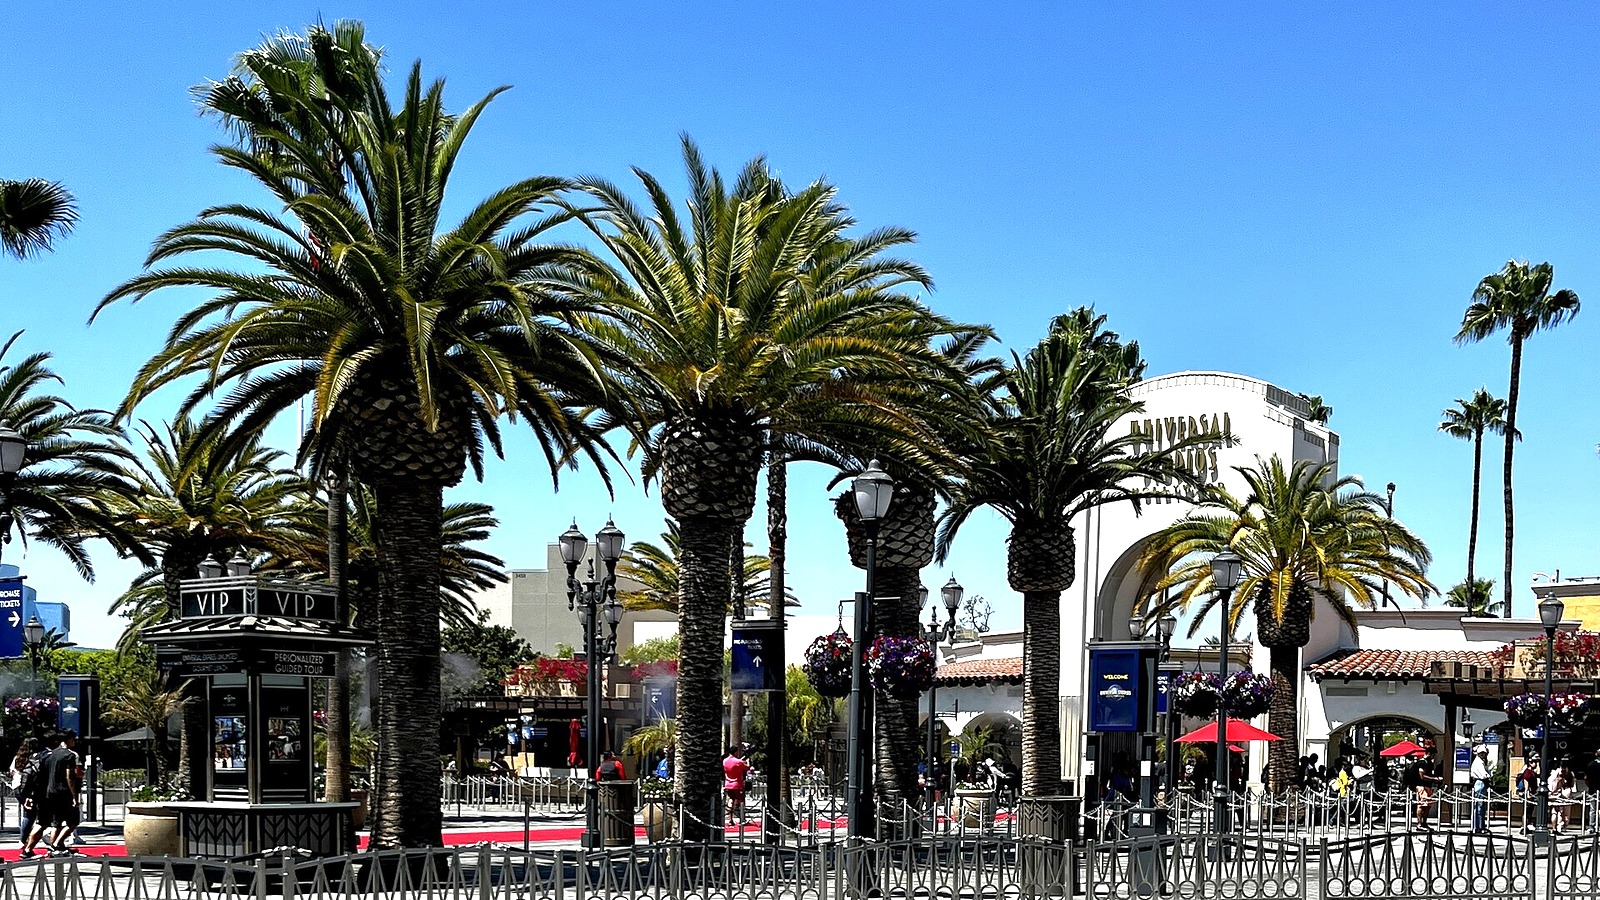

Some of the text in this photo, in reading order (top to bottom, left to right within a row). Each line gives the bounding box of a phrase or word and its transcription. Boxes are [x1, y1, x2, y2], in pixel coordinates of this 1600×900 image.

[196, 592, 229, 615] VIP
[275, 592, 315, 617] VIP
[274, 652, 324, 664] PERSONALIZED
[274, 663, 324, 674] GUIDED TOUR
[1555, 740, 1568, 749] 10
